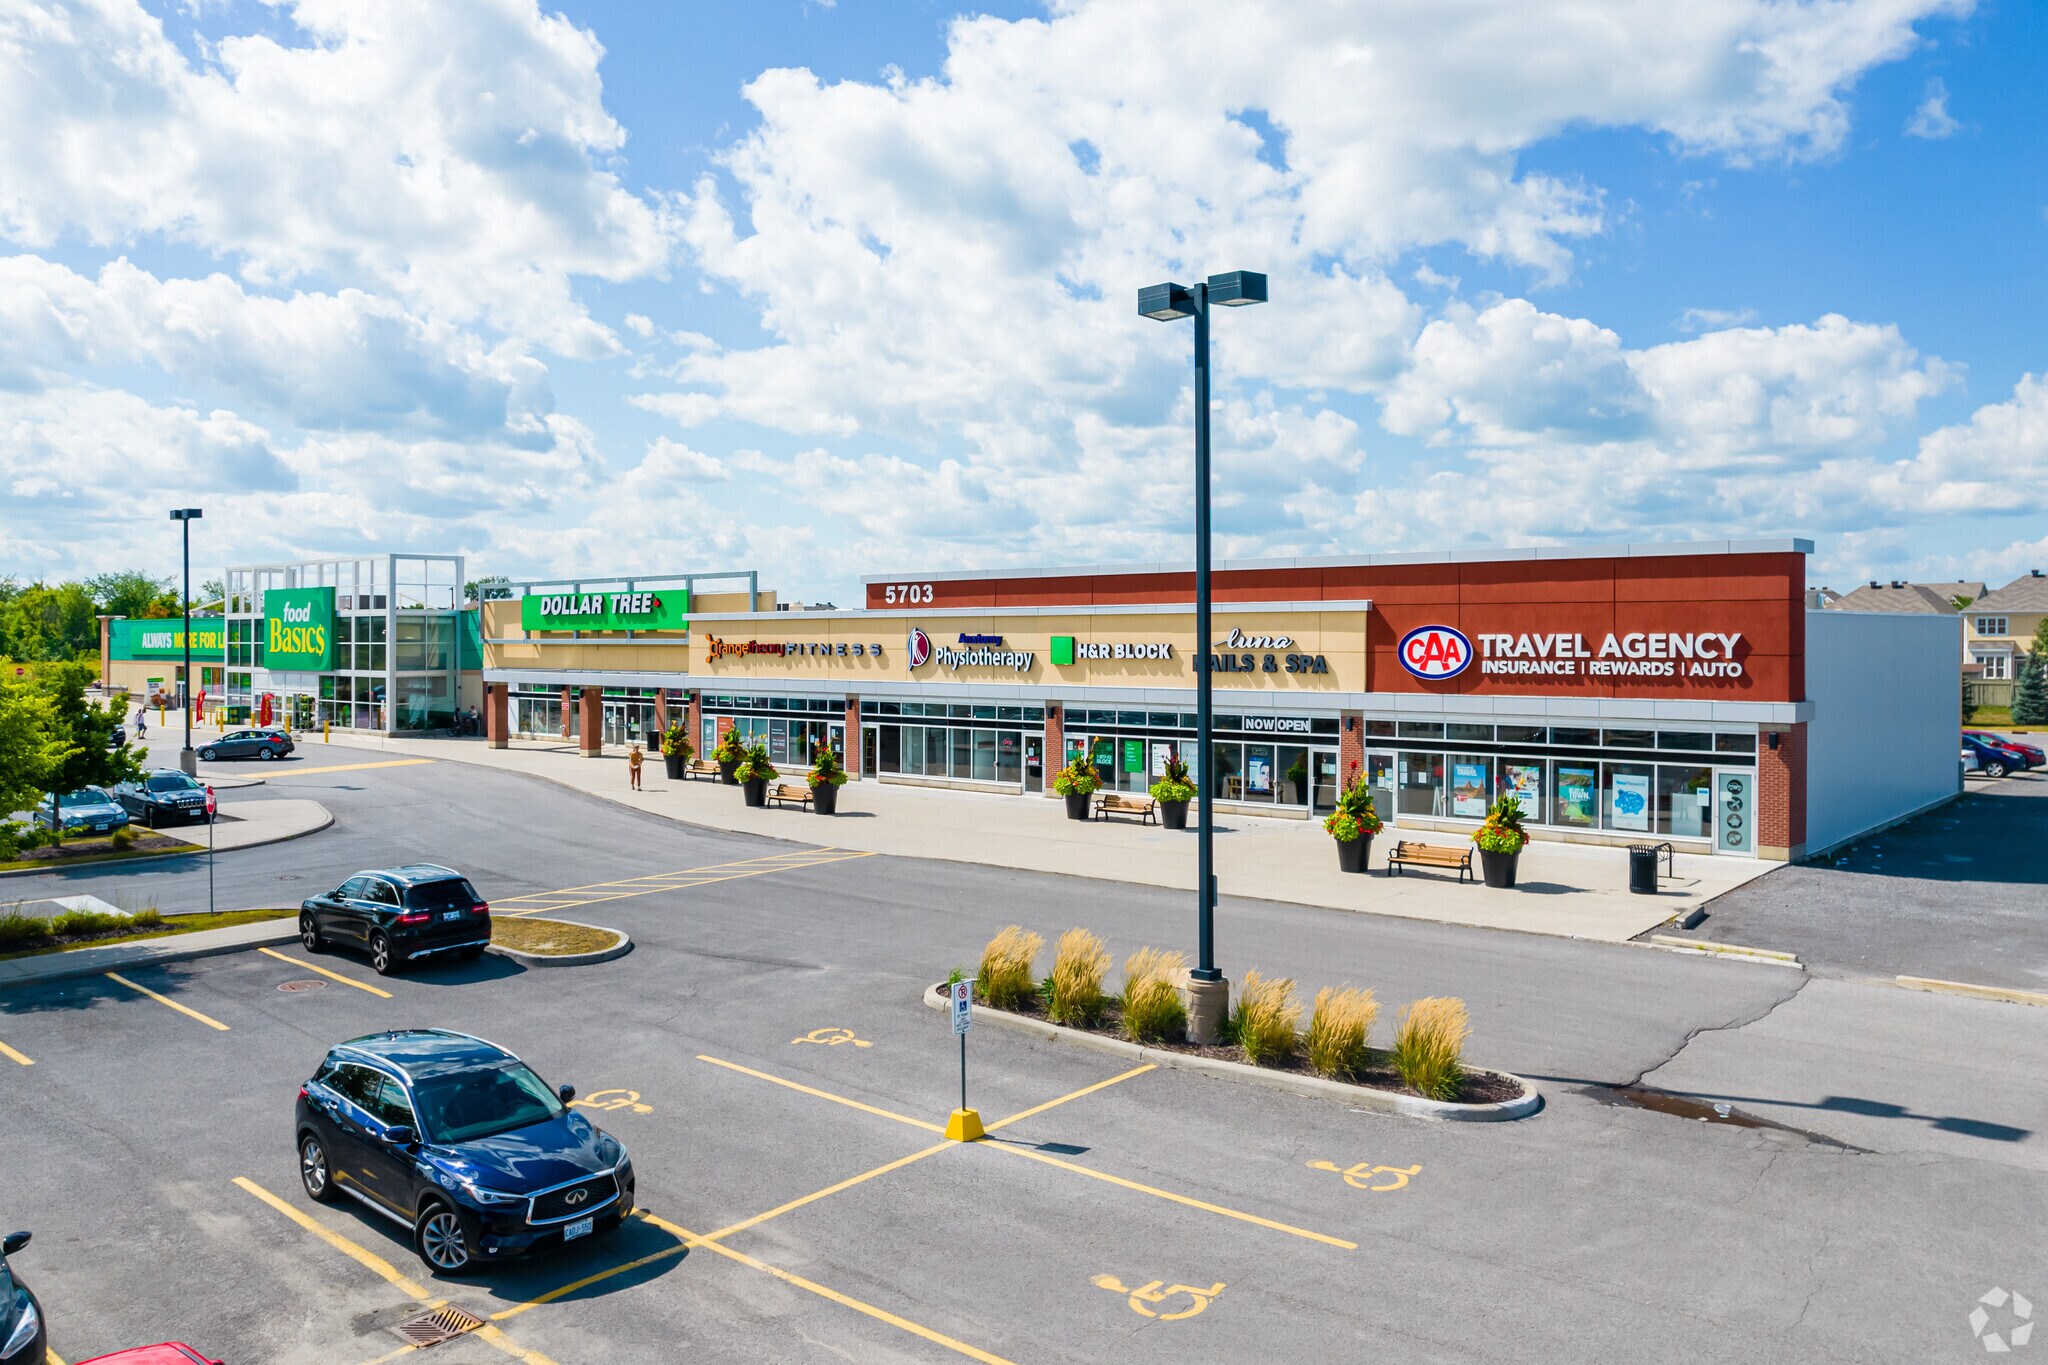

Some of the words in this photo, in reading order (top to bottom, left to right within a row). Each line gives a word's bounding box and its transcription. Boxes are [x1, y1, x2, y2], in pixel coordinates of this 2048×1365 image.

[885, 584, 933, 604] 5703
[283, 601, 311, 622] food
[540, 595, 603, 616] DOLLAR
[610, 593, 653, 614] TREE
[142, 632, 172, 648] ALWAYS
[200, 631, 216, 649] FOR
[958, 632, 1003, 647] Anatomy
[1212, 628, 1294, 650] luna
[1477, 633, 1591, 658] TRAVEL
[1598, 632, 1742, 660] AGENCY
[786, 642, 882, 657] FITNESS
[935, 646, 1034, 672] Physiotherapy
[1077, 643, 1111, 659] H&R
[1114, 643, 1172, 659] BLOCK
[1407, 632, 1462, 671] CAA
[1262, 654, 1278, 673] &
[1285, 654, 1328, 674] SPA
[1481, 660, 1576, 675] INSURANCE
[1589, 661, 1674, 677] REWARDS
[1689, 662, 1743, 677] AUTO
[1246, 718, 1274, 730] NOW
[1278, 719, 1309, 732] OPEN
